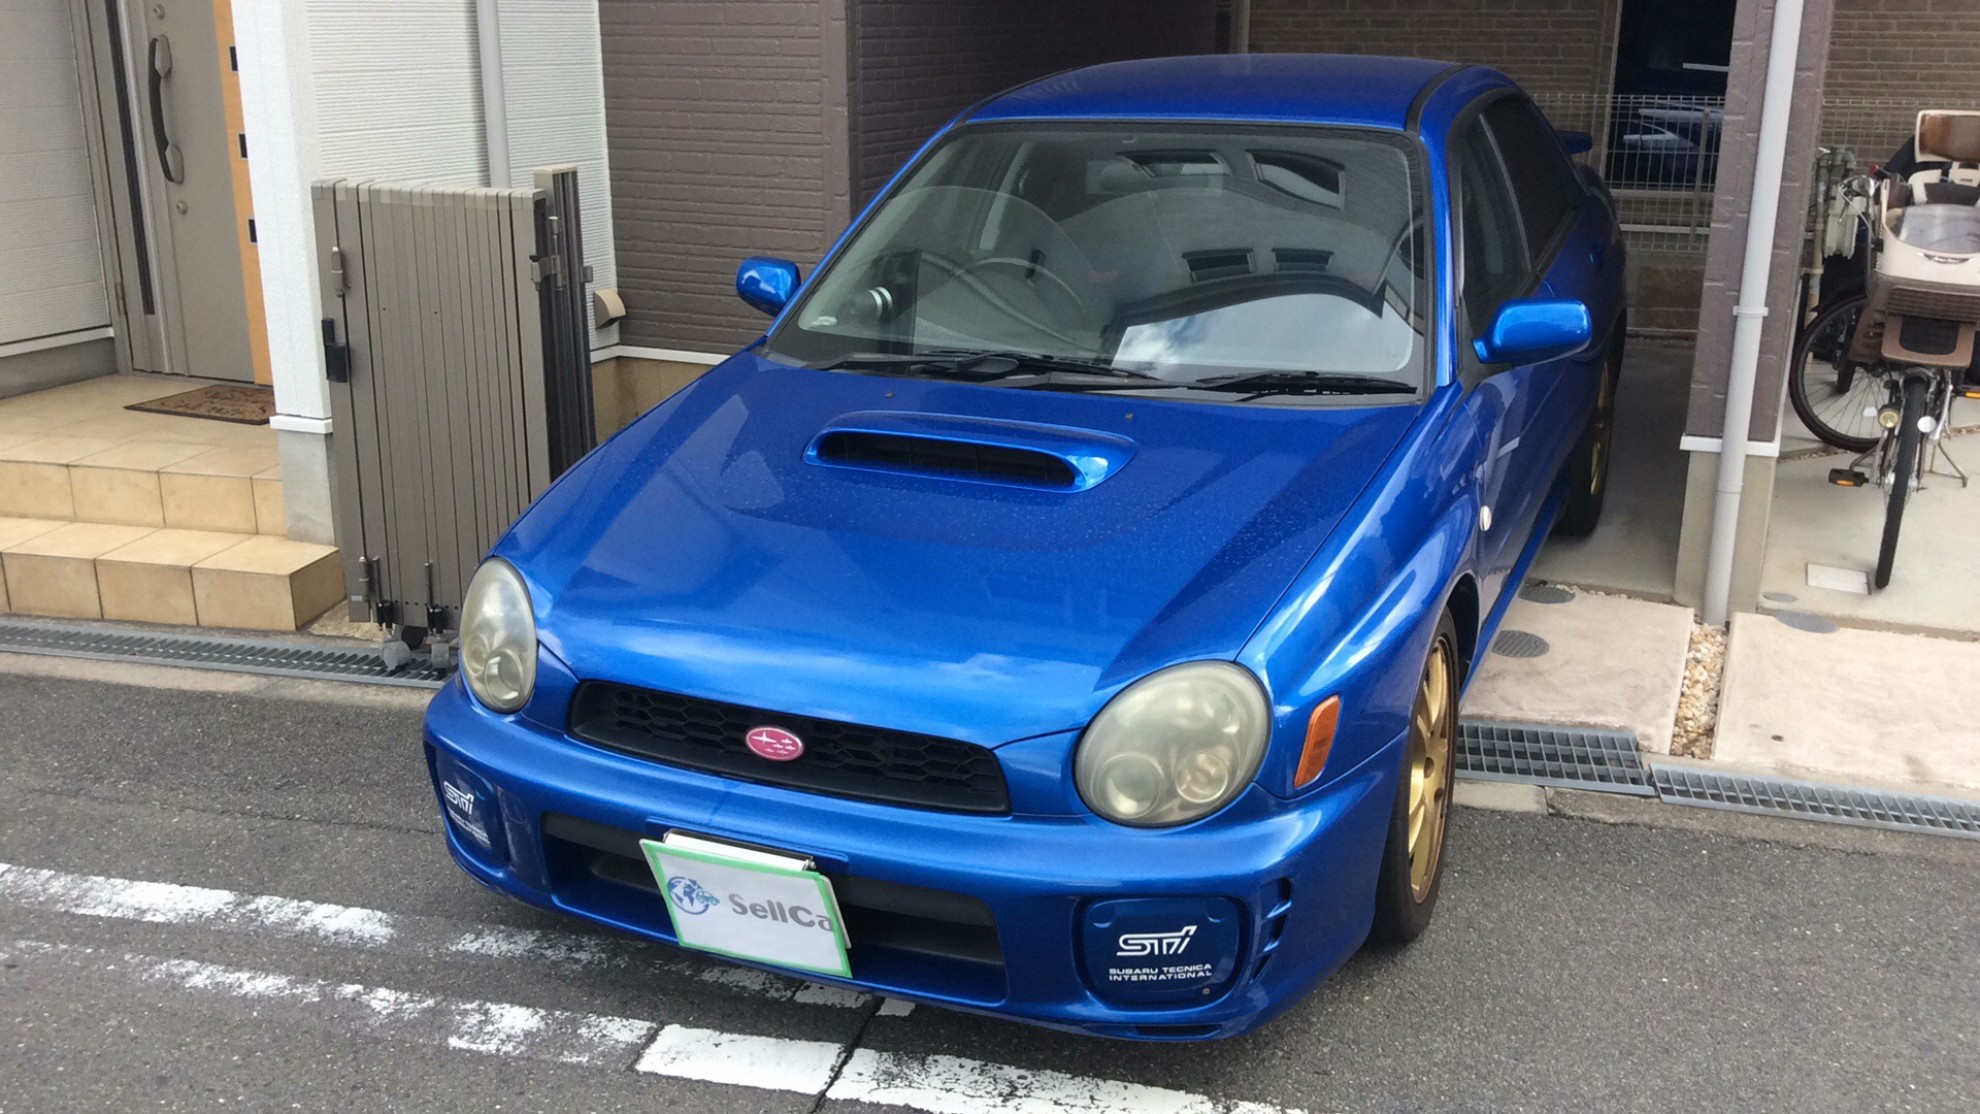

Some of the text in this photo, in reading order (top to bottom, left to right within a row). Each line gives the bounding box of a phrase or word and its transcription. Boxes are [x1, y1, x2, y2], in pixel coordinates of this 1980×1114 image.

[1108, 963, 1213, 975] SUBARU TECNICA
[1108, 971, 1213, 981] INTERNATIONAL
